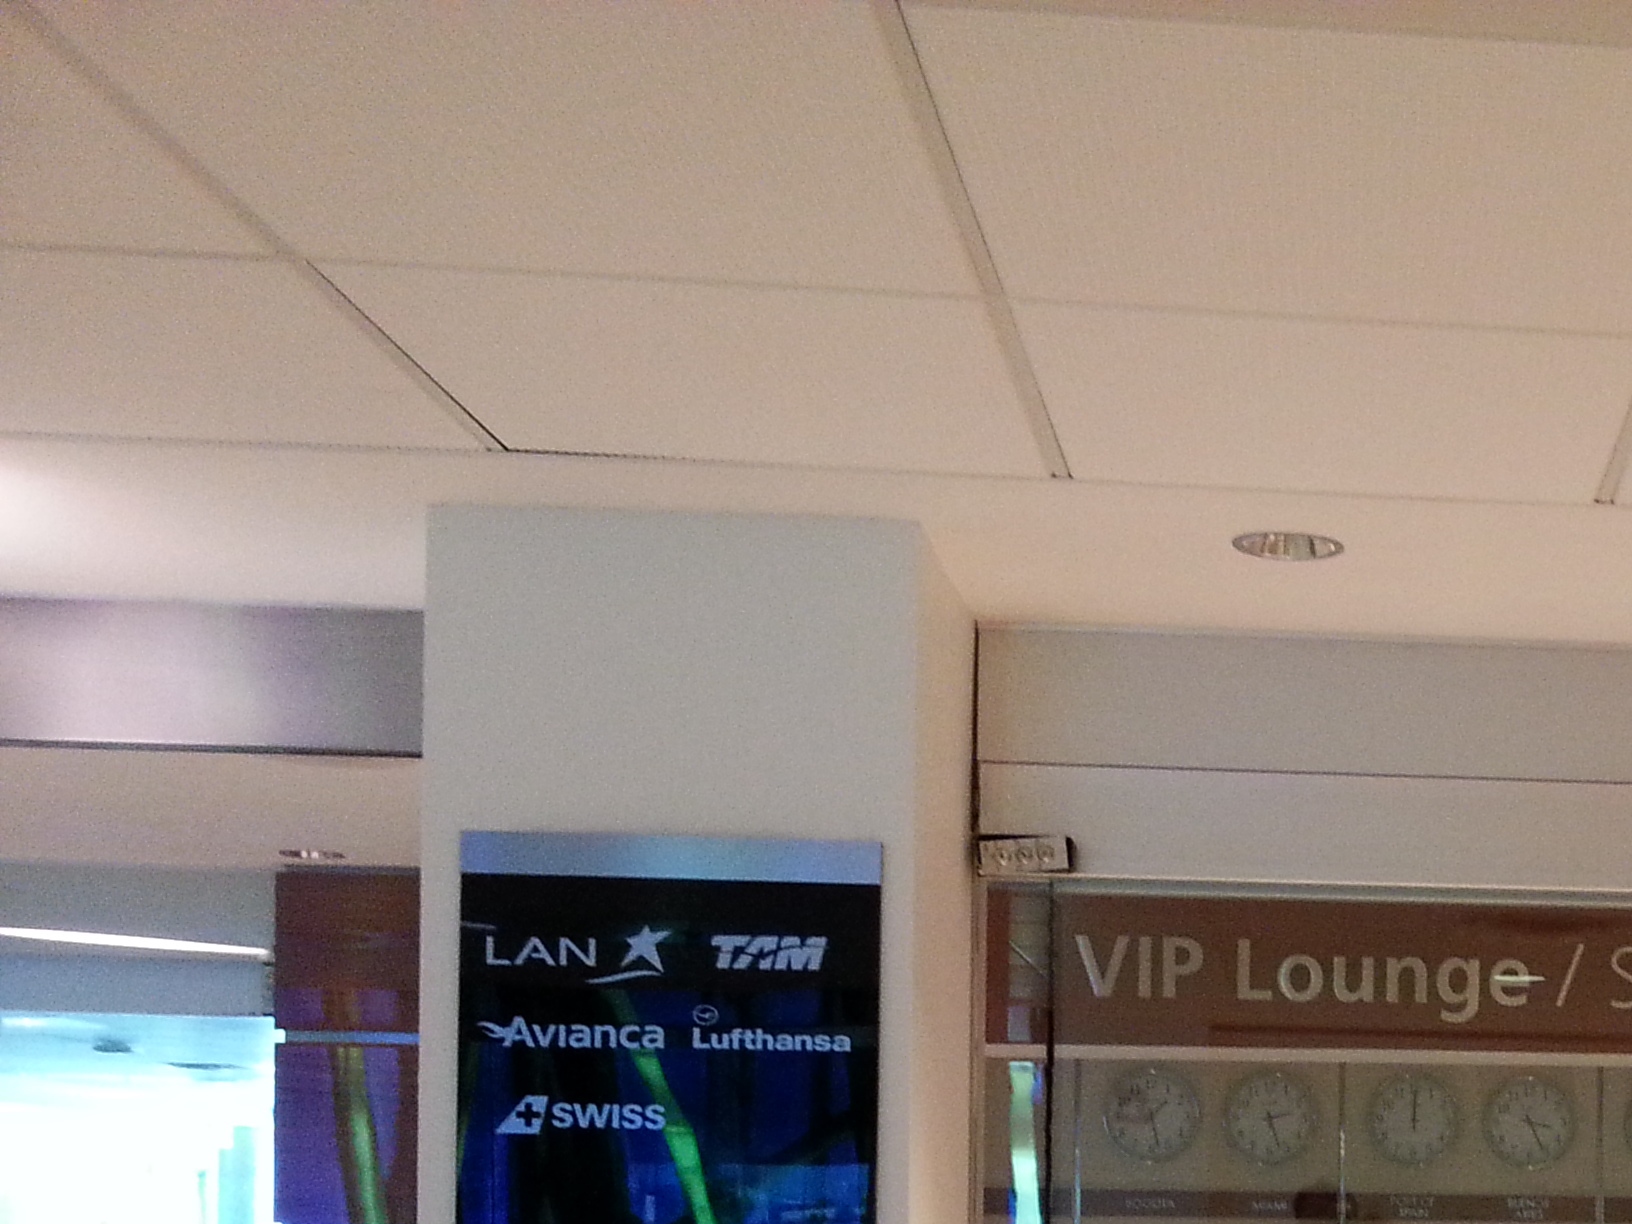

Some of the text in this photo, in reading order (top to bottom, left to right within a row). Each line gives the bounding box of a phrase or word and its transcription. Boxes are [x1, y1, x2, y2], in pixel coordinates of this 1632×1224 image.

[485, 935, 597, 967] LAN
[710, 934, 828, 971] TAM
[1075, 934, 1204, 999] VIP
[1236, 938, 1530, 1025] Lounge
[1554, 943, 1586, 1008] /
[501, 1016, 665, 1049] Avianca
[692, 1027, 852, 1052] Lufthansa
[552, 1102, 667, 1131] SWISS
